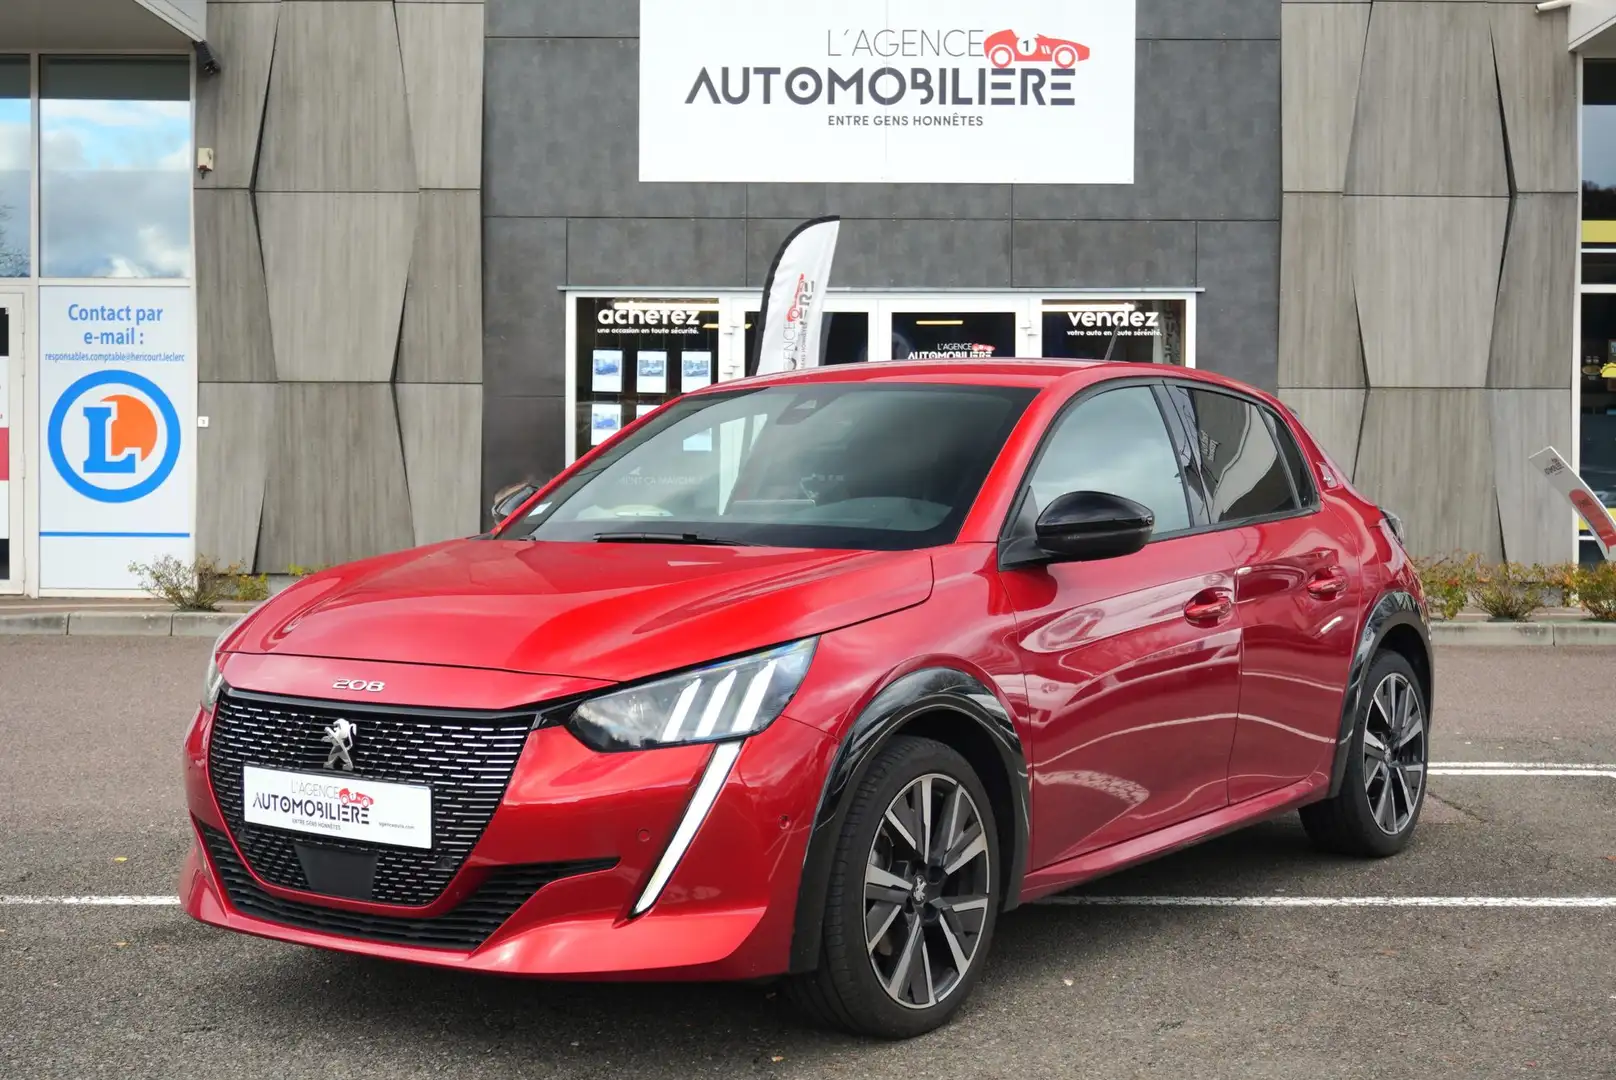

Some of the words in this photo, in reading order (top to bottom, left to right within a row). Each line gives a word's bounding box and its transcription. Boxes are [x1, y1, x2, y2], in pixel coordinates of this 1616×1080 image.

[827, 29, 984, 57] L'AGENCE
[828, 115, 869, 126] ENTRE
[873, 115, 908, 126] GENS
[913, 113, 983, 126] HONNÊTES
[68, 304, 132, 322] Contact
[136, 308, 163, 326] par
[597, 300, 700, 325] achetez
[1067, 302, 1160, 327] vendez
[84, 327, 135, 345] e-mail
[332, 678, 386, 692] 208
[291, 780, 340, 800] L'AGENCE
